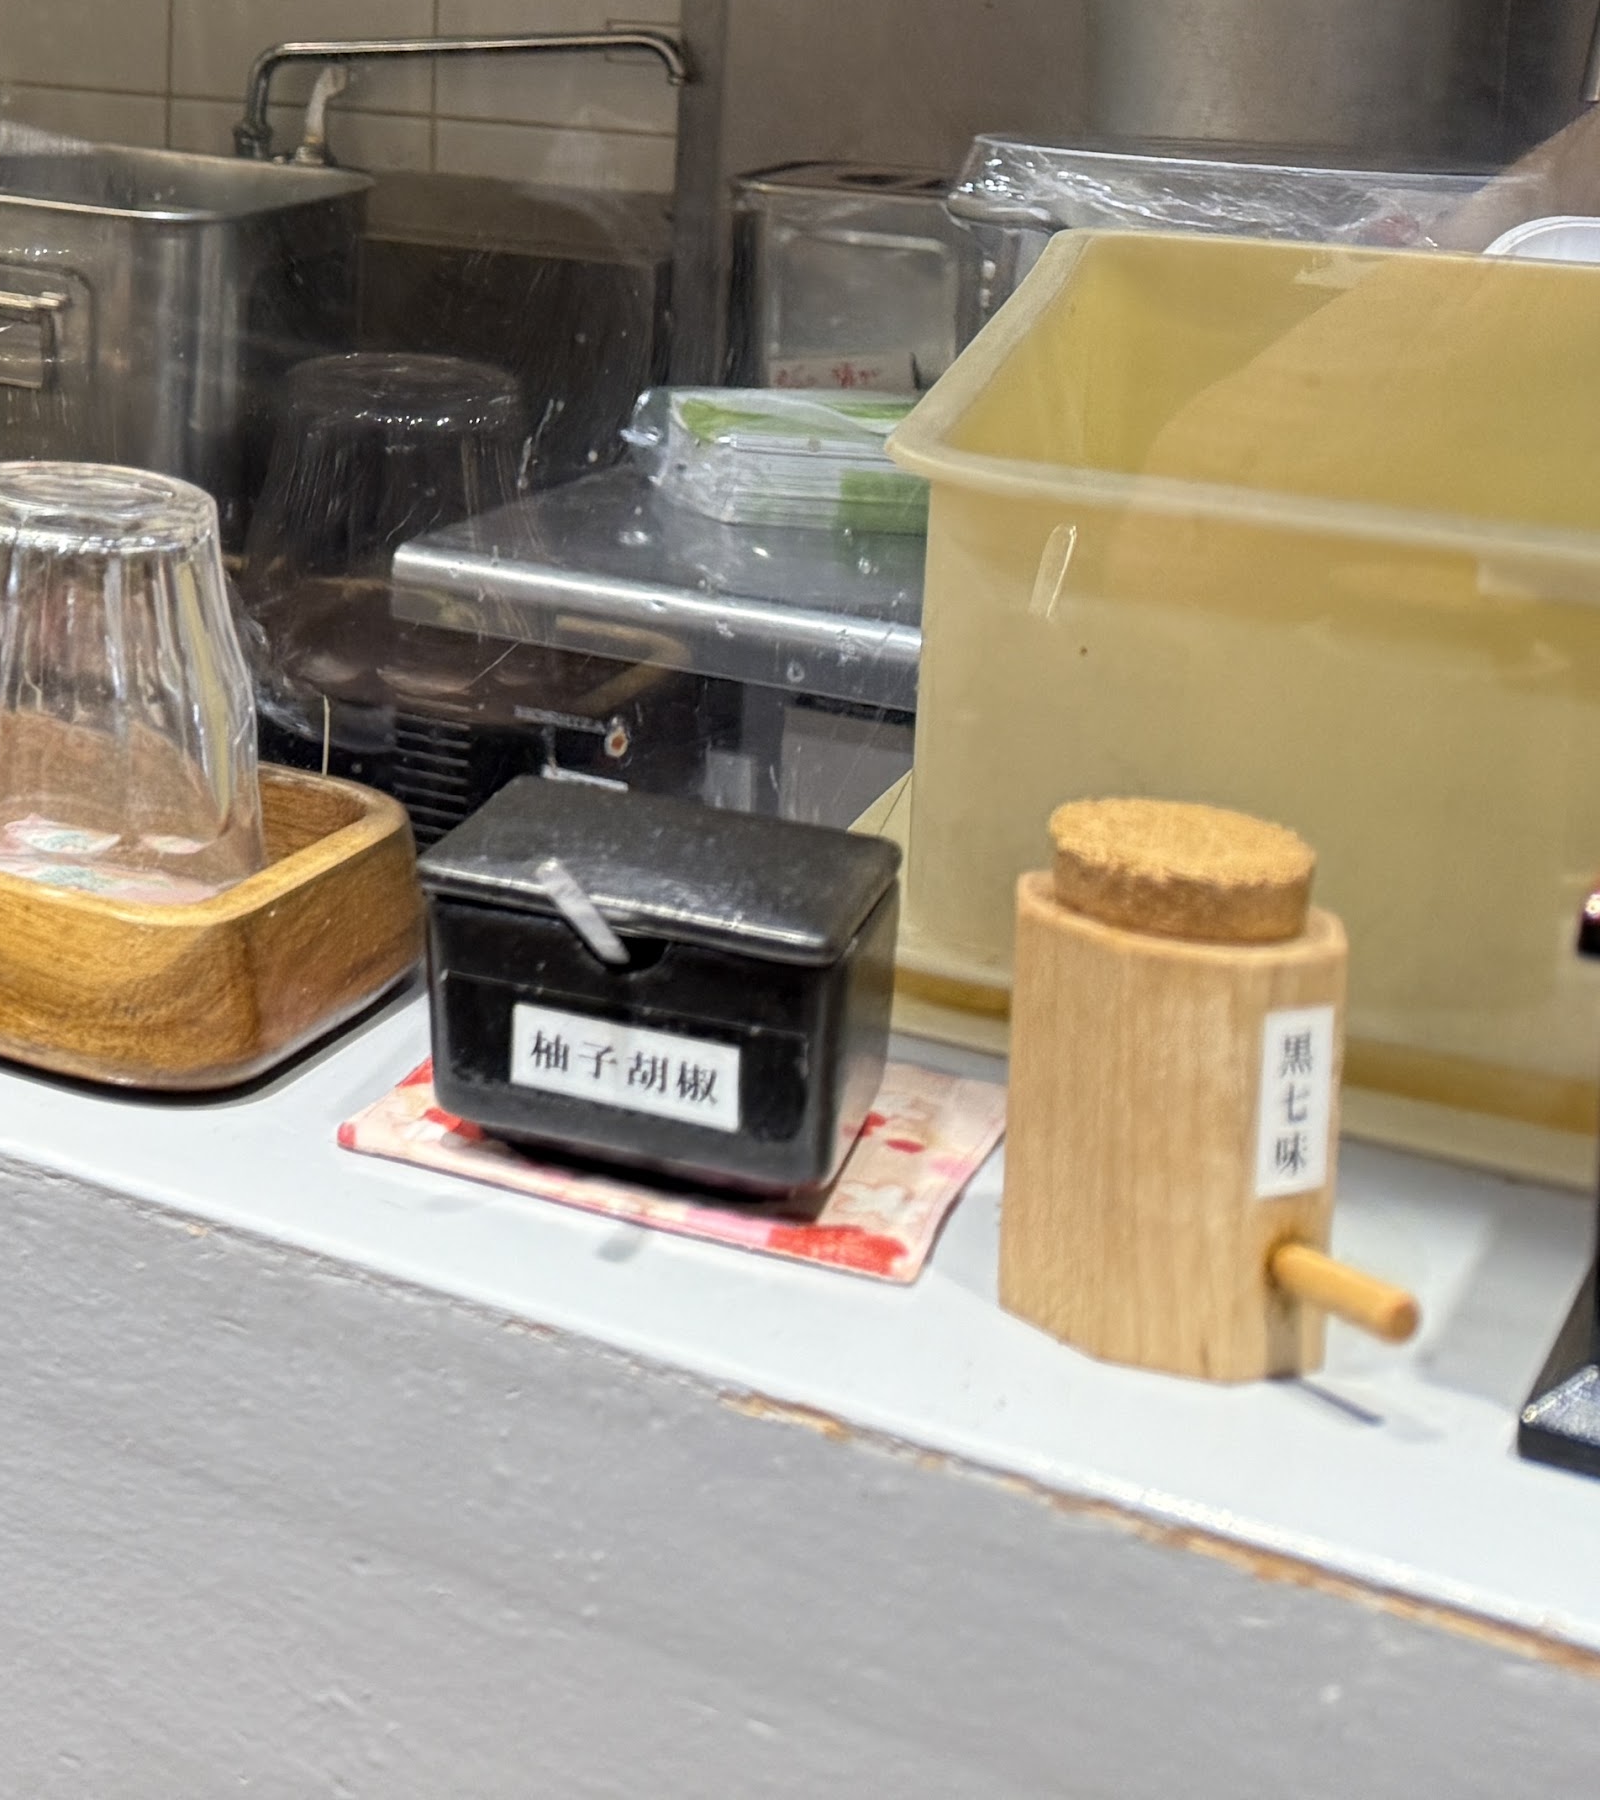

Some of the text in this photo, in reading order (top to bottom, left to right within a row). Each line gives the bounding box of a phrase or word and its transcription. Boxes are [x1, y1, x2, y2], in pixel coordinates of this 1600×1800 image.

[531, 1029, 718, 1104] 柚子胡椒
[1276, 1031, 1312, 1175] 黒七味
